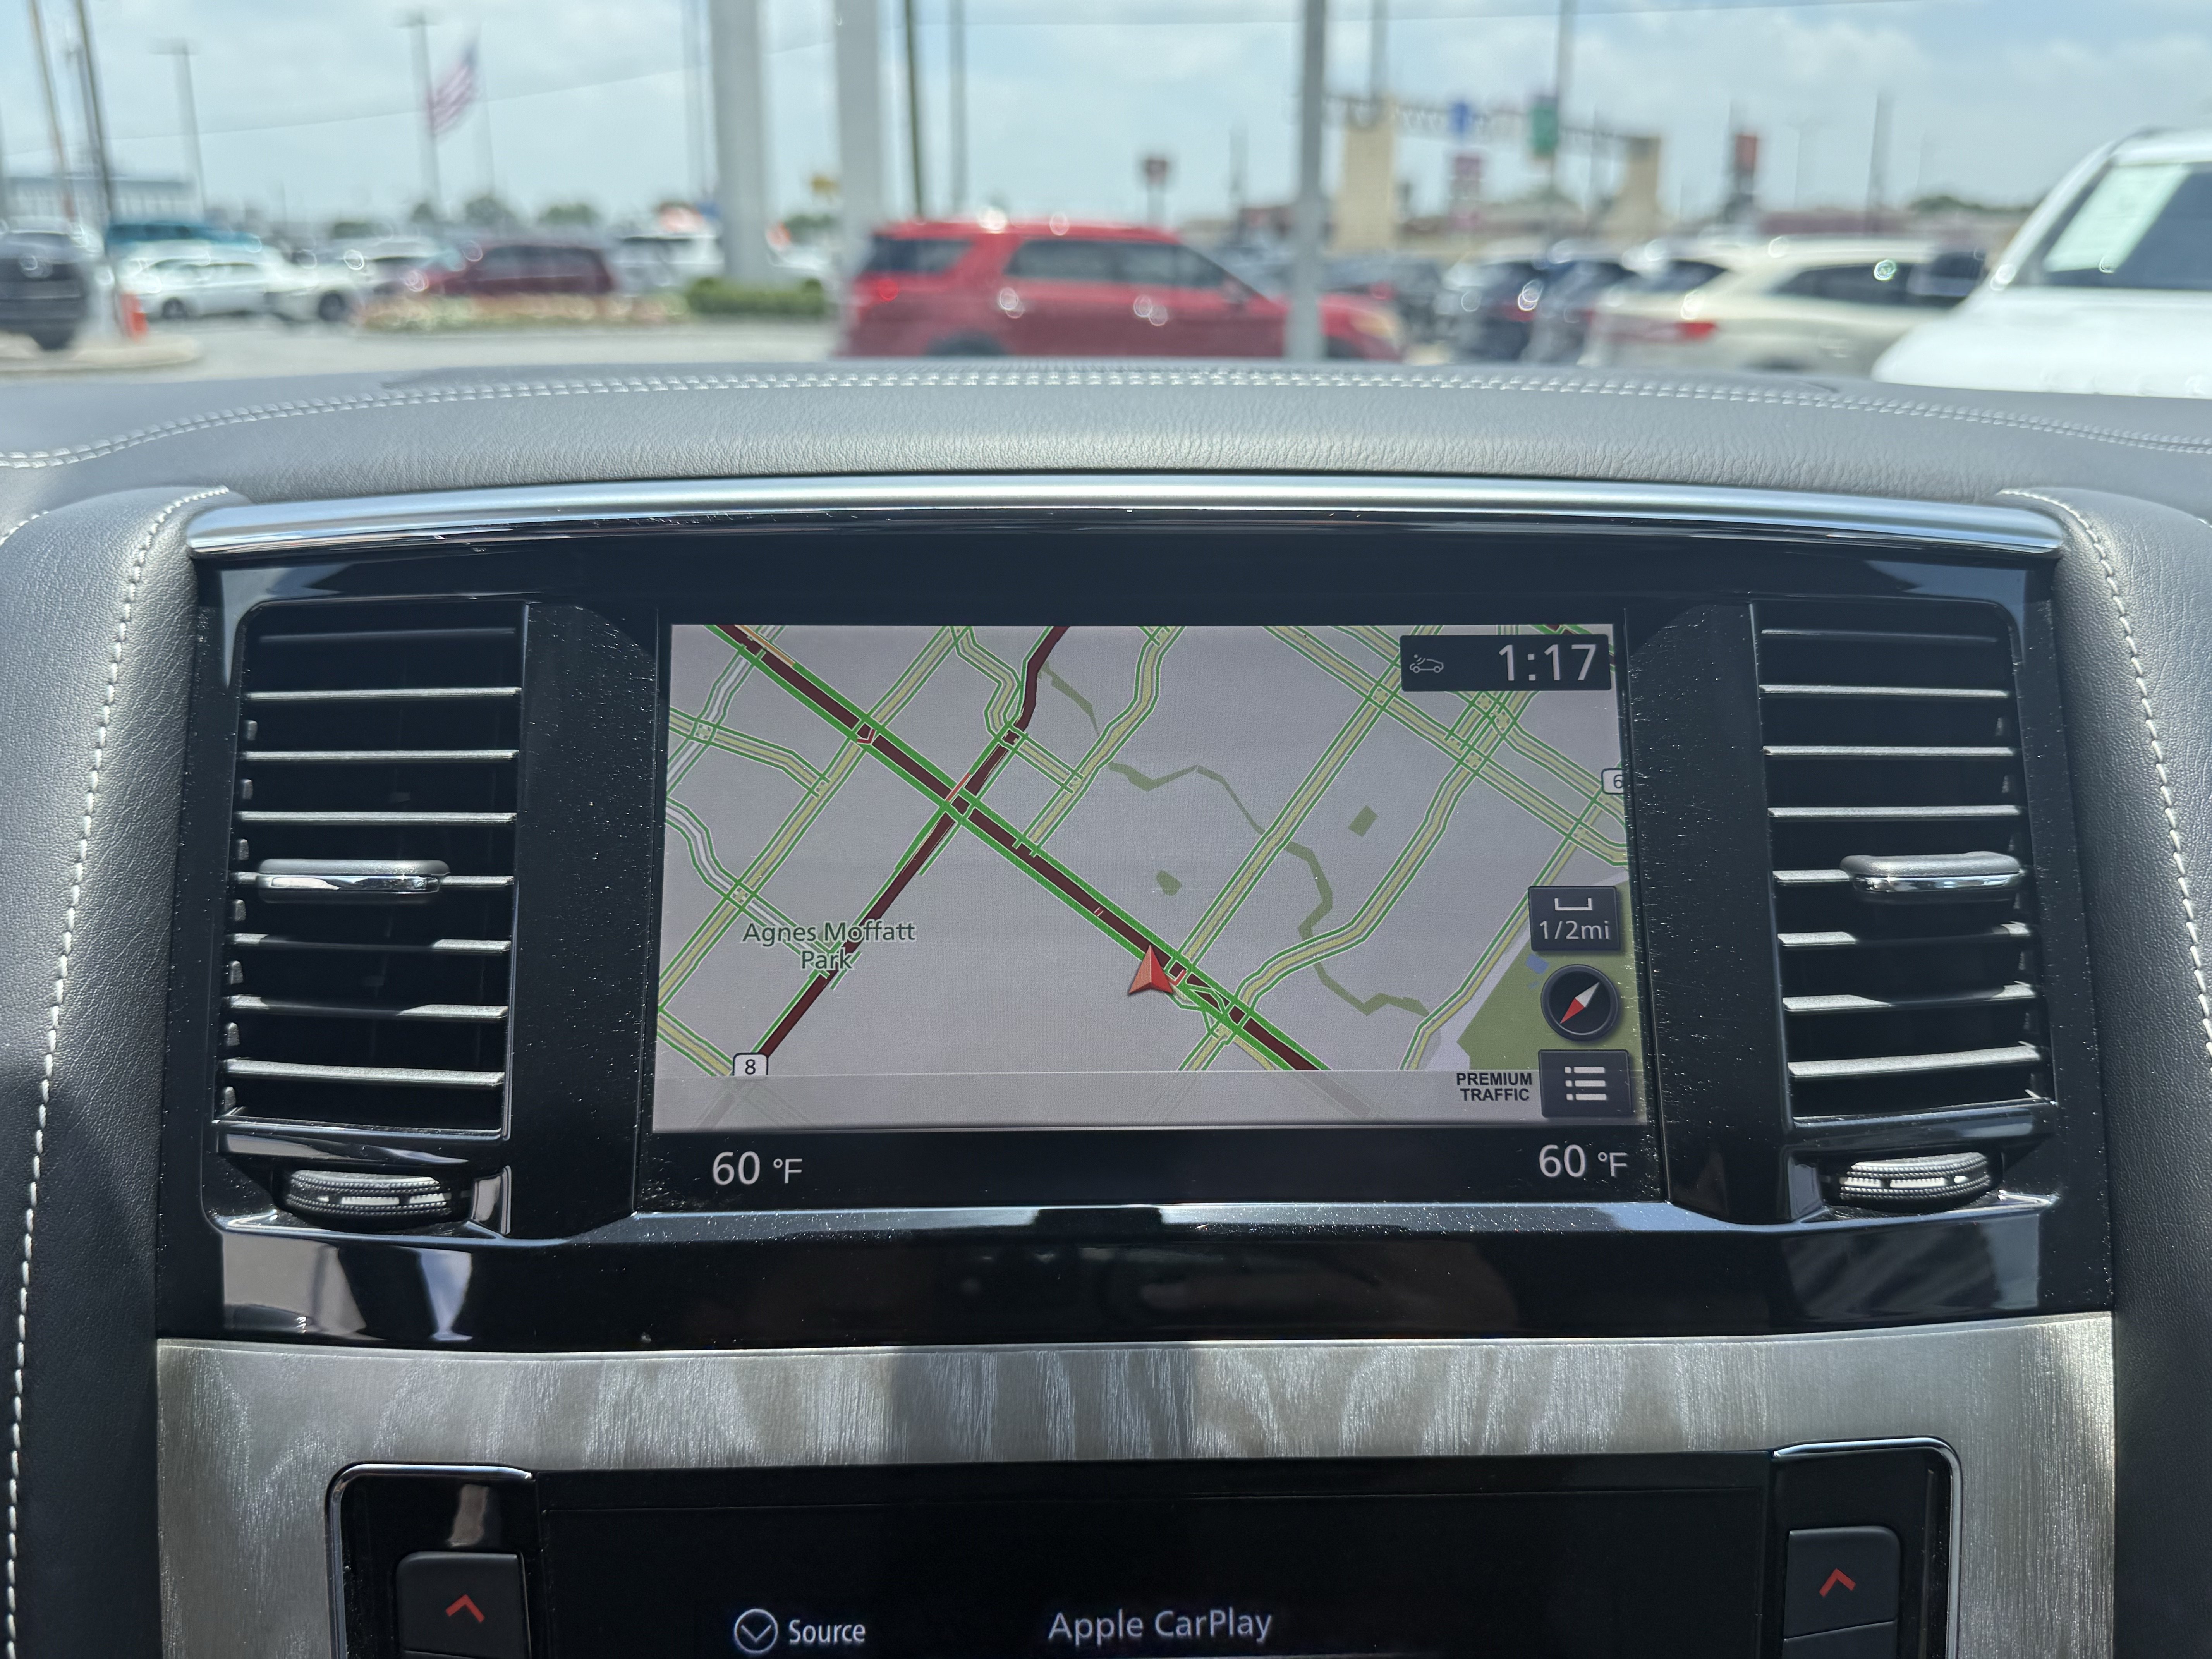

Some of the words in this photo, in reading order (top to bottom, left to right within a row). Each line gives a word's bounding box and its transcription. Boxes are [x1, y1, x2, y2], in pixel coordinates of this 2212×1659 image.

[1498, 644, 1597, 681] 1:17
[742, 923, 816, 947] Agnes
[824, 921, 915, 941] Moffatt
[1539, 920, 1610, 939] 1/2mi
[802, 948, 853, 969] Park
[745, 1058, 756, 1075] 8
[1456, 1072, 1532, 1085] PREMIUM
[1460, 1088, 1530, 1101] TRAFFIC
[712, 1151, 761, 1185] 60
[1539, 1144, 1586, 1178] 60
[788, 1619, 866, 1645] Source
[1047, 1608, 1144, 1647] Apple
[1154, 1606, 1272, 1644] CarPlay
